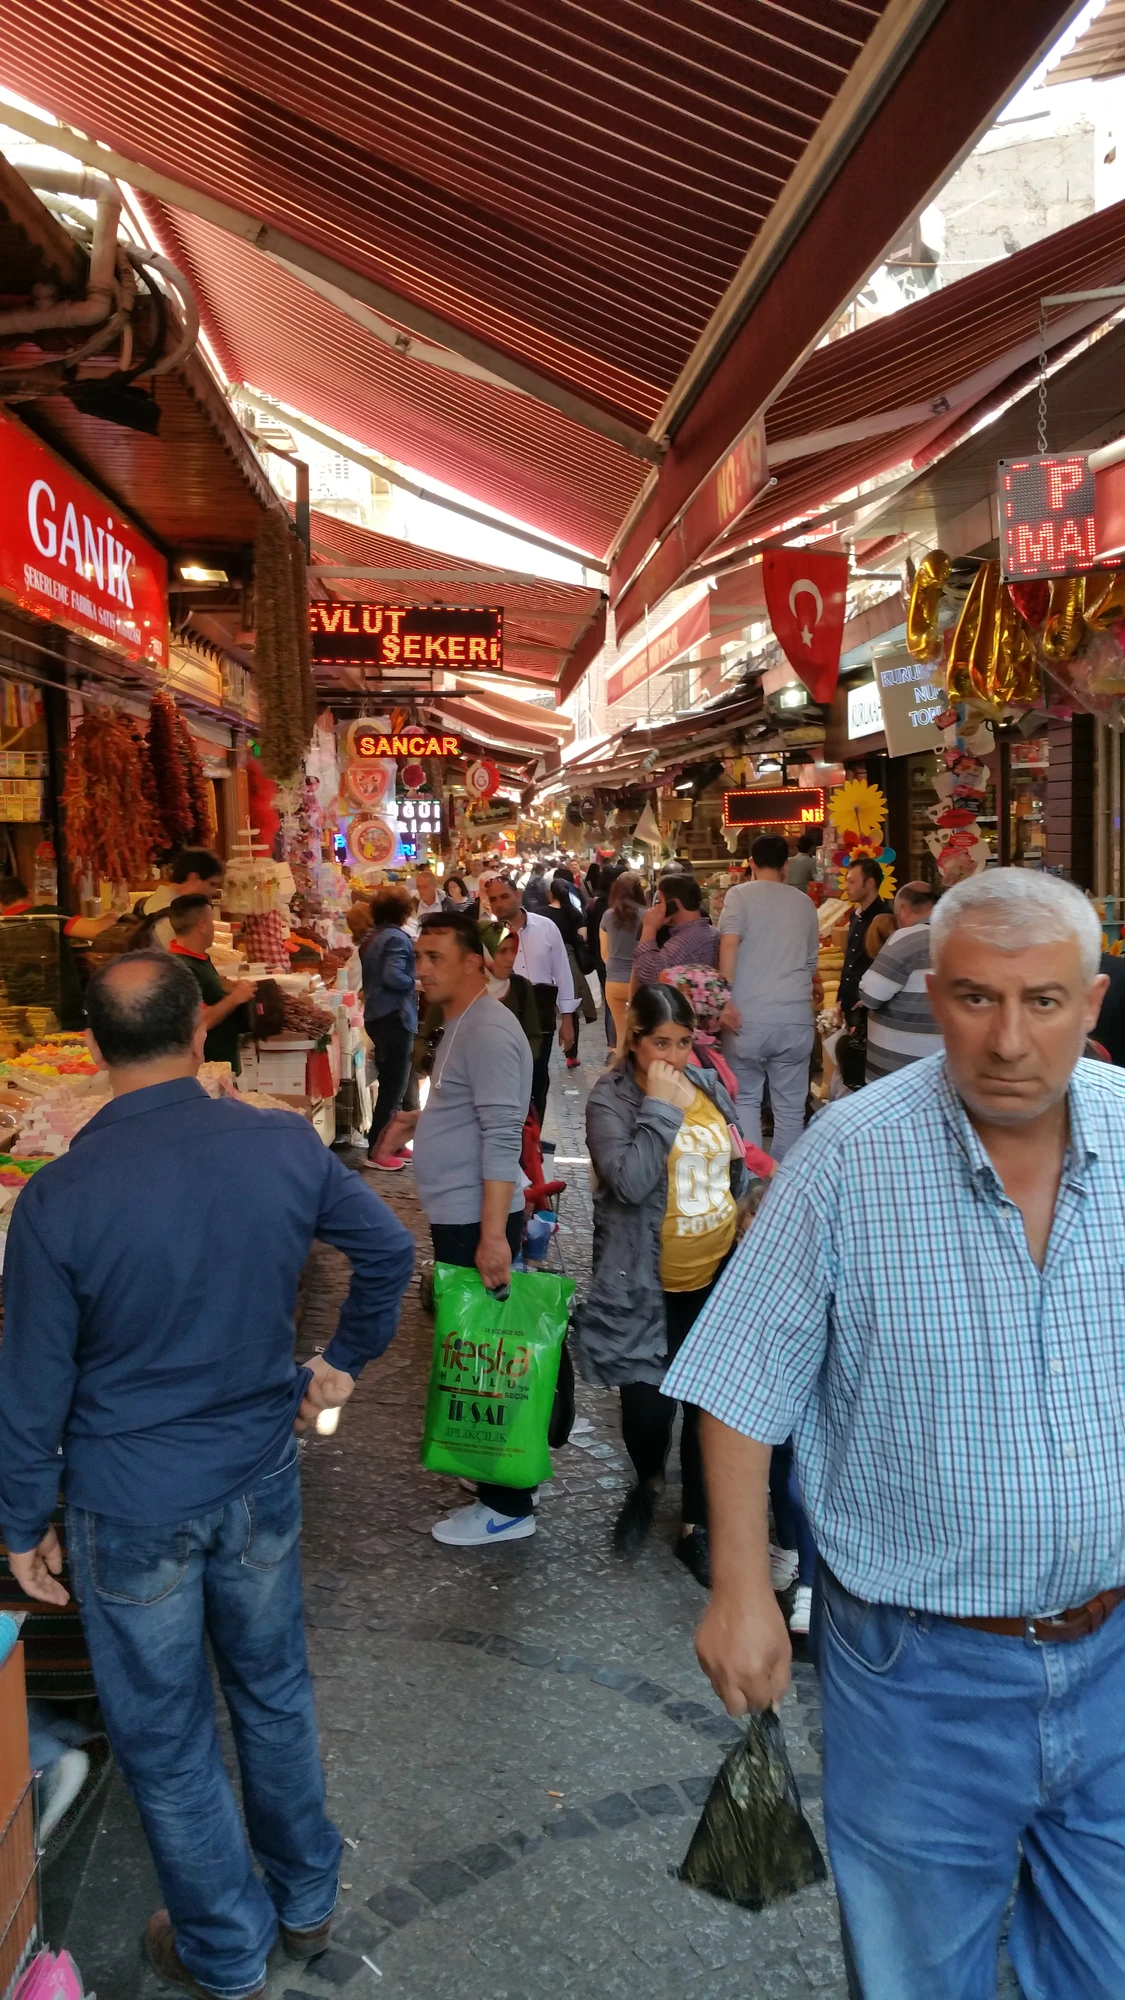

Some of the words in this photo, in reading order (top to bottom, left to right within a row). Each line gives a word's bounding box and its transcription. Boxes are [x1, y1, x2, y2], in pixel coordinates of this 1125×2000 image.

[28, 479, 134, 609] GANİK
[24, 563, 70, 606] ŞEKERLEME
[98, 606, 116, 636] SATIŞ
[360, 737, 459, 755] SANCAR
[441, 1331, 529, 1377] fiesta
